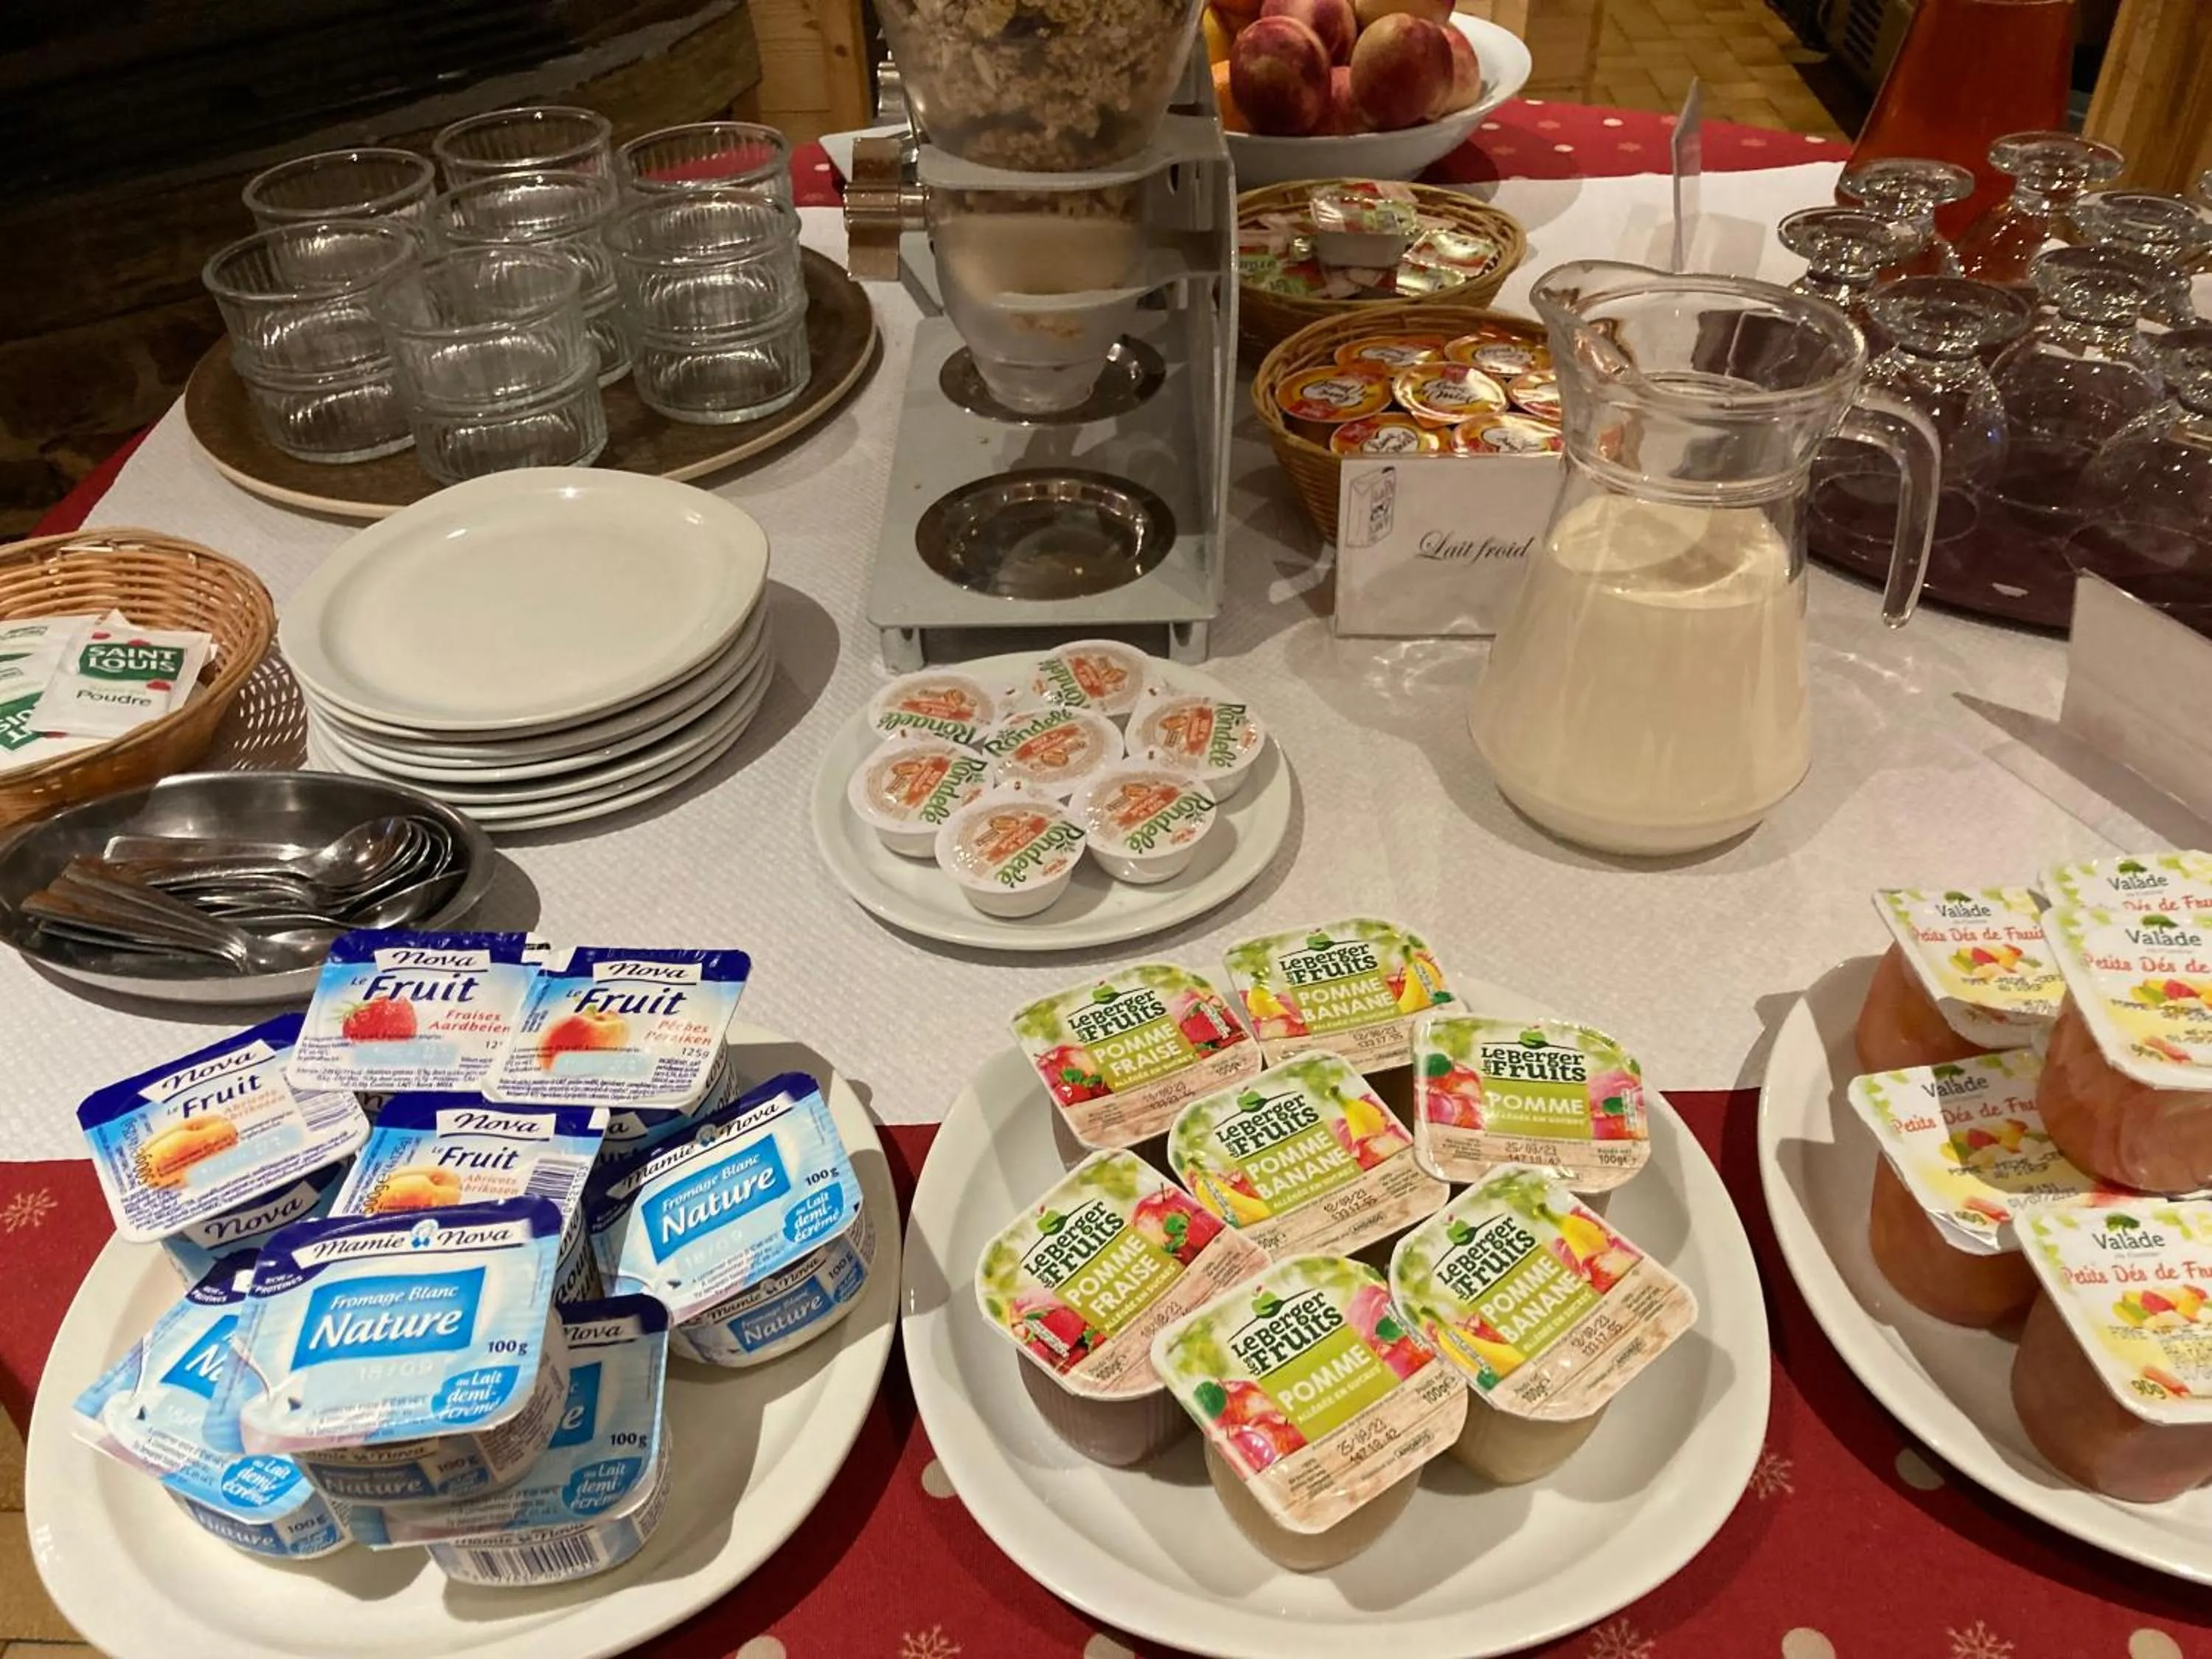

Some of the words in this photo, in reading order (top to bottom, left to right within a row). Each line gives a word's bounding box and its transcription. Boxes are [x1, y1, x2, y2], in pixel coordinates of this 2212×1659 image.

[1417, 532, 1472, 561] Lait
[1470, 537, 1534, 566] froid
[88, 645, 178, 661] SAINT
[88, 657, 176, 674] LOUIS
[76, 689, 153, 708] Poudre
[2107, 873, 2169, 891] Valade
[1935, 903, 1992, 919] Valade
[1983, 928, 2001, 941] de
[2004, 925, 2045, 941] Fruit
[2125, 928, 2202, 947] Valade
[392, 950, 476, 967] Nova
[608, 961, 689, 979] Nova
[1293, 954, 1378, 984] Fruits
[2139, 956, 2177, 973] Dés
[2185, 958, 2212, 974] de
[351, 975, 368, 987] Le
[363, 972, 479, 1003] Fruit
[566, 988, 582, 998] Le
[574, 987, 688, 1015] Fruit
[1298, 976, 1384, 1006] POMME
[446, 1009, 502, 1022] Fraises
[1085, 1001, 1167, 1042] Fruits
[1301, 991, 1395, 1023] BANANE
[429, 1020, 512, 1034] Aardbeien
[681, 1047, 711, 1059] 125g
[1093, 1022, 1178, 1063] POMME
[162, 1050, 258, 1091] Nova
[1109, 1042, 1182, 1078] FRAISE
[1492, 1060, 1587, 1082] Fruits
[182, 1074, 262, 1119] Fruit
[1921, 1075, 1990, 1099] Valade
[1484, 1091, 1584, 1115] POMME
[1891, 1116, 1937, 1134] Petits
[1940, 1109, 1974, 1125] Dés
[1980, 1102, 2003, 1119] de
[453, 1112, 540, 1133] Nova
[1238, 1104, 1321, 1156] Fruits
[437, 1145, 521, 1171] Fruit
[622, 1144, 695, 1189] Mamie
[717, 1104, 780, 1137] Nova
[1245, 1130, 1333, 1180] POMME
[662, 1170, 720, 1213] Fromage
[722, 1152, 760, 1178] Blanc
[1254, 1147, 1352, 1201] BANANE
[661, 1166, 778, 1245] Nature
[805, 1192, 830, 1210] Lait
[204, 1196, 305, 1241] Nova
[313, 1232, 406, 1259] Mamie
[437, 1227, 512, 1247] Nova
[1047, 1210, 1125, 1286] Fruits
[2092, 1231, 2166, 1252] Valade
[1064, 1234, 1148, 1309] POMME
[1464, 1229, 1537, 1296] Fruits
[2061, 1266, 2109, 1285] Petits
[2112, 1264, 2148, 1283] Dés
[2154, 1262, 2180, 1281] de
[330, 1287, 405, 1310] Fromage
[408, 1284, 459, 1301] Blanc
[1088, 1253, 1162, 1319] FRAISE
[1479, 1254, 1561, 1323] POMME
[743, 1294, 824, 1346] Nature
[1499, 1271, 1585, 1346] BANANE
[308, 1308, 463, 1350] Nature
[1253, 1302, 1343, 1374] Fruits
[470, 1370, 502, 1385] Lait
[1277, 1343, 1372, 1412] POMME
[447, 1386, 498, 1403] demi-
[598, 1462, 627, 1477] Lait
